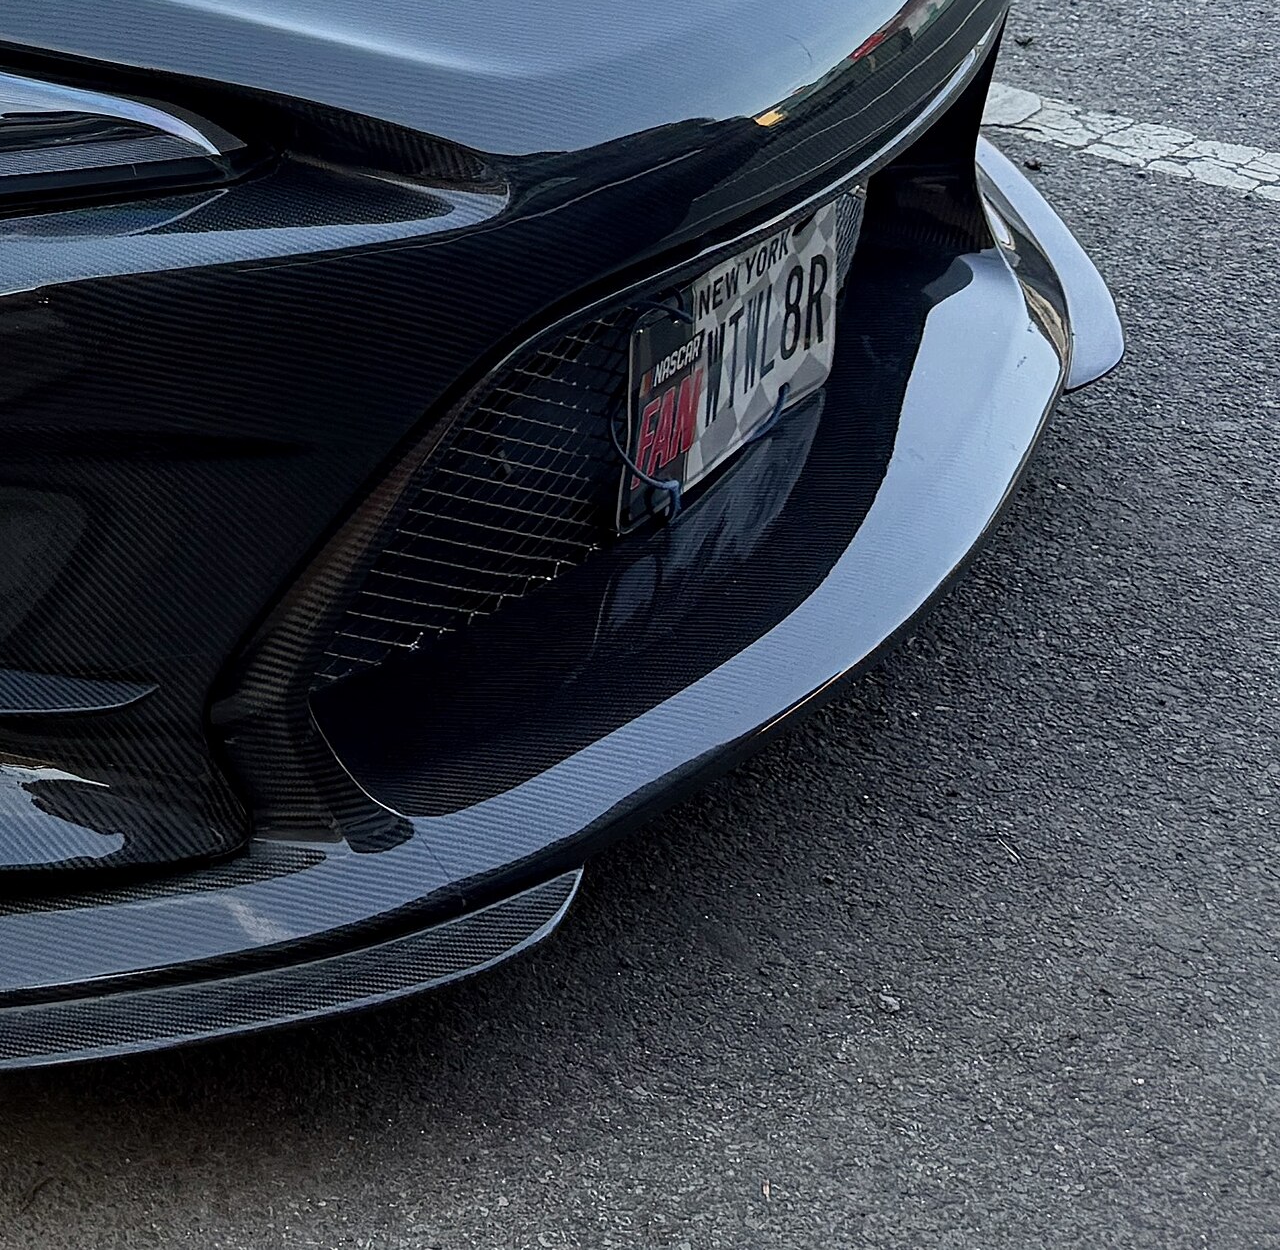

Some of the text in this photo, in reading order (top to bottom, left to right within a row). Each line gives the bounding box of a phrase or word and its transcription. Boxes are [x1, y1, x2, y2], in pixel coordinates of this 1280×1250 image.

[698, 227, 790, 321] NEW YORK
[653, 333, 702, 388] NASCAR
[630, 367, 704, 491] FAN
